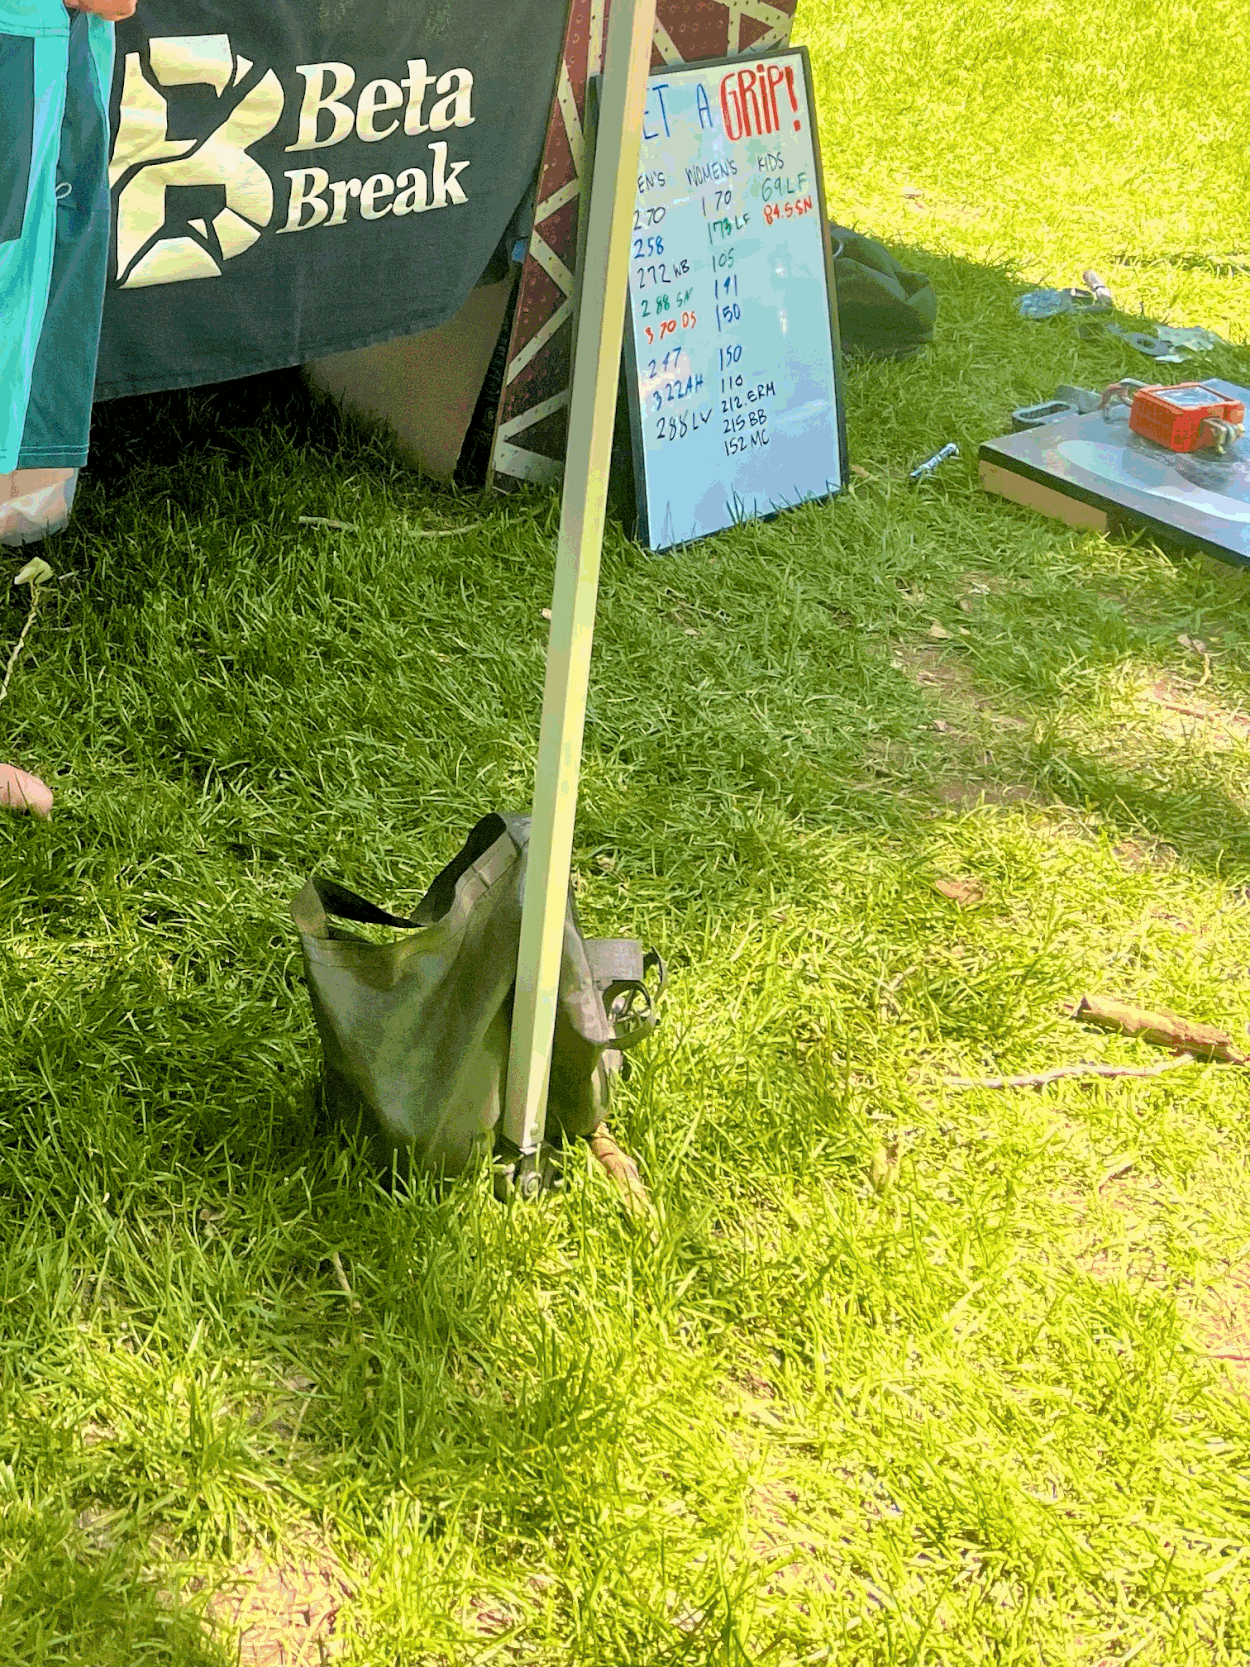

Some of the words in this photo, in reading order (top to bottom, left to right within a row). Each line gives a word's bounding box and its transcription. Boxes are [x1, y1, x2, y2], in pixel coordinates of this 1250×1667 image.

[284, 57, 476, 153] Beta
[642, 84, 671, 140] ET
[696, 82, 714, 130] A
[636, 170, 667, 194] EN'S
[685, 158, 739, 187] WOMEN'S
[757, 151, 785, 173] KIDS
[275, 141, 471, 234] Break
[633, 206, 667, 231] 270
[633, 235, 665, 260] 258
[712, 247, 735, 273] 105
[636, 263, 672, 289] 272
[715, 302, 742, 333] 150
[719, 344, 743, 372] 150
